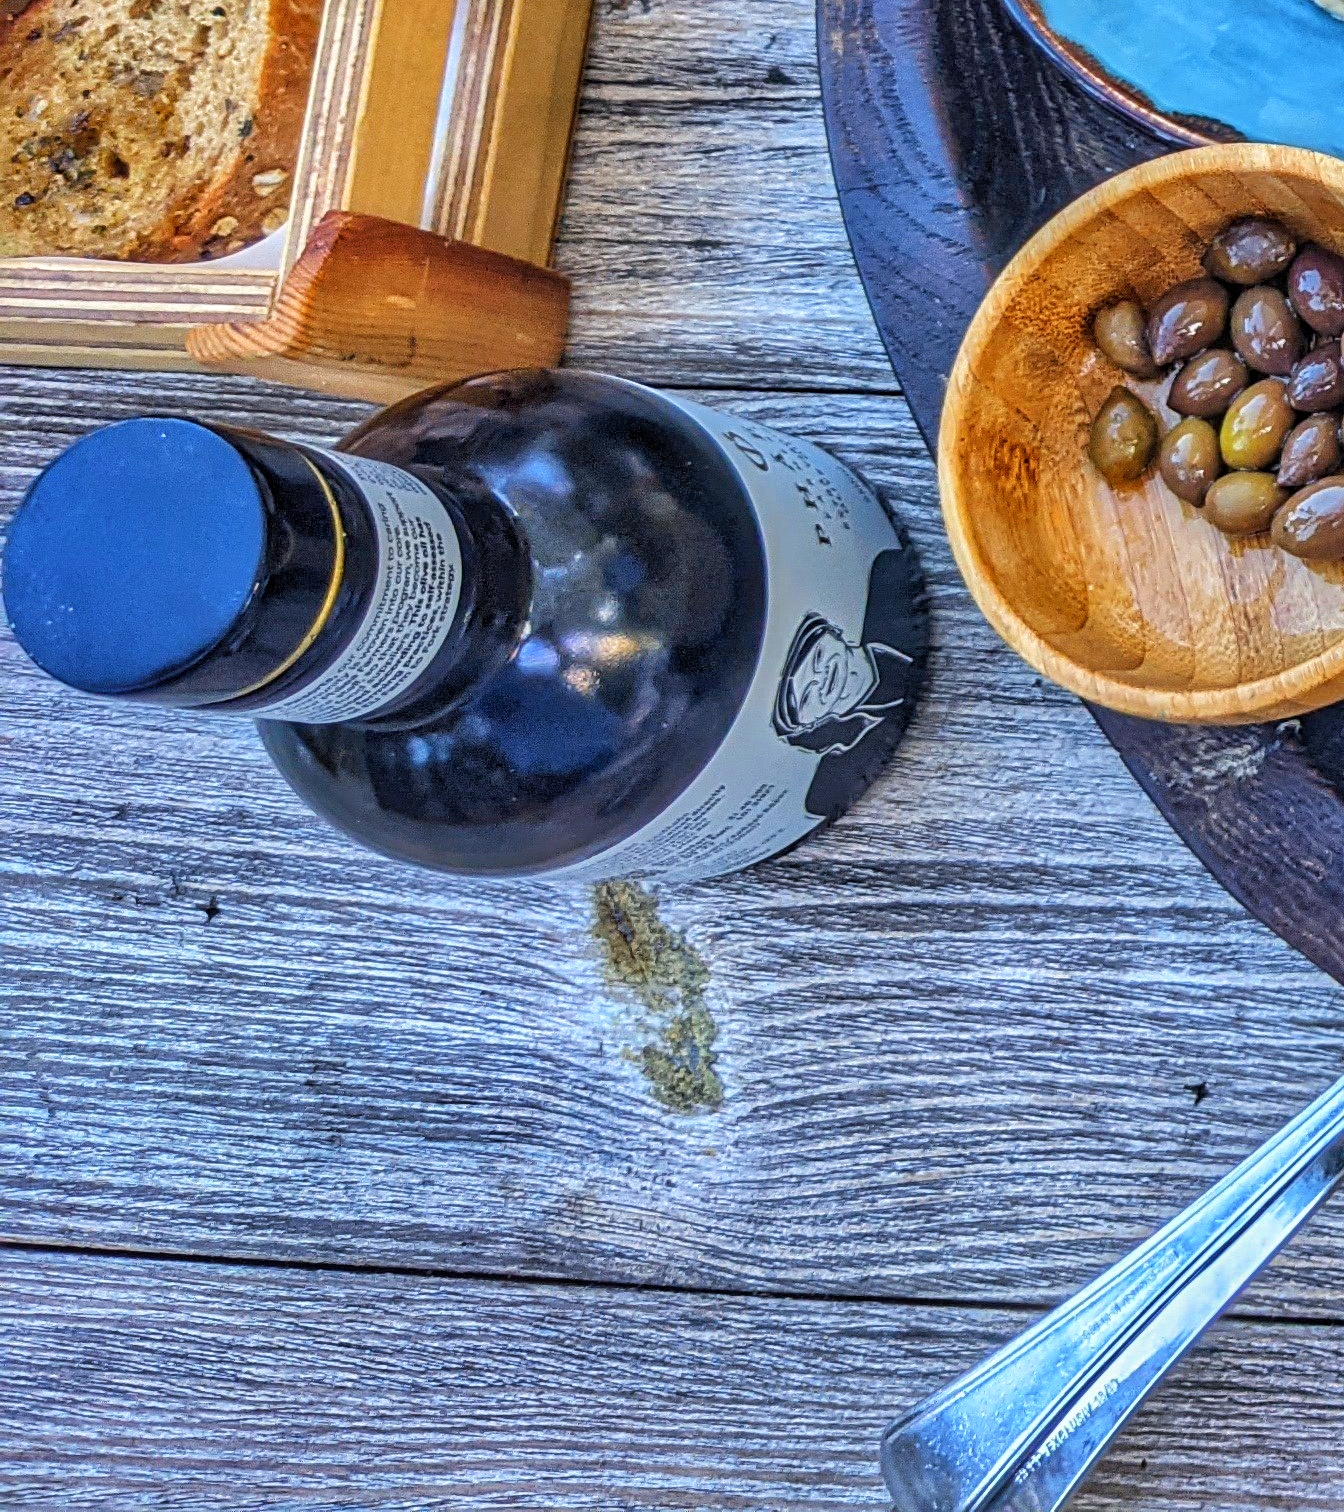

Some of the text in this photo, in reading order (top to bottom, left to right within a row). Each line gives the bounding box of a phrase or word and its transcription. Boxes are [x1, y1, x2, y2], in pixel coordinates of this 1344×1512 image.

[377, 503, 393, 542] caring
[415, 516, 425, 538] has
[387, 546, 394, 560] to
[405, 540, 411, 560] we
[420, 542, 429, 558] oil
[436, 533, 445, 555] the
[436, 559, 445, 603] within
[356, 566, 393, 651] commitment
[359, 618, 390, 659] woven
[385, 588, 399, 614] into
[395, 561, 403, 584] our
[378, 635, 400, 661] that
[396, 603, 413, 633] they
[408, 543, 421, 599] become
[408, 598, 424, 626] This
[371, 630, 422, 687] according
[418, 612, 428, 627] to
[410, 656, 423, 669] to
